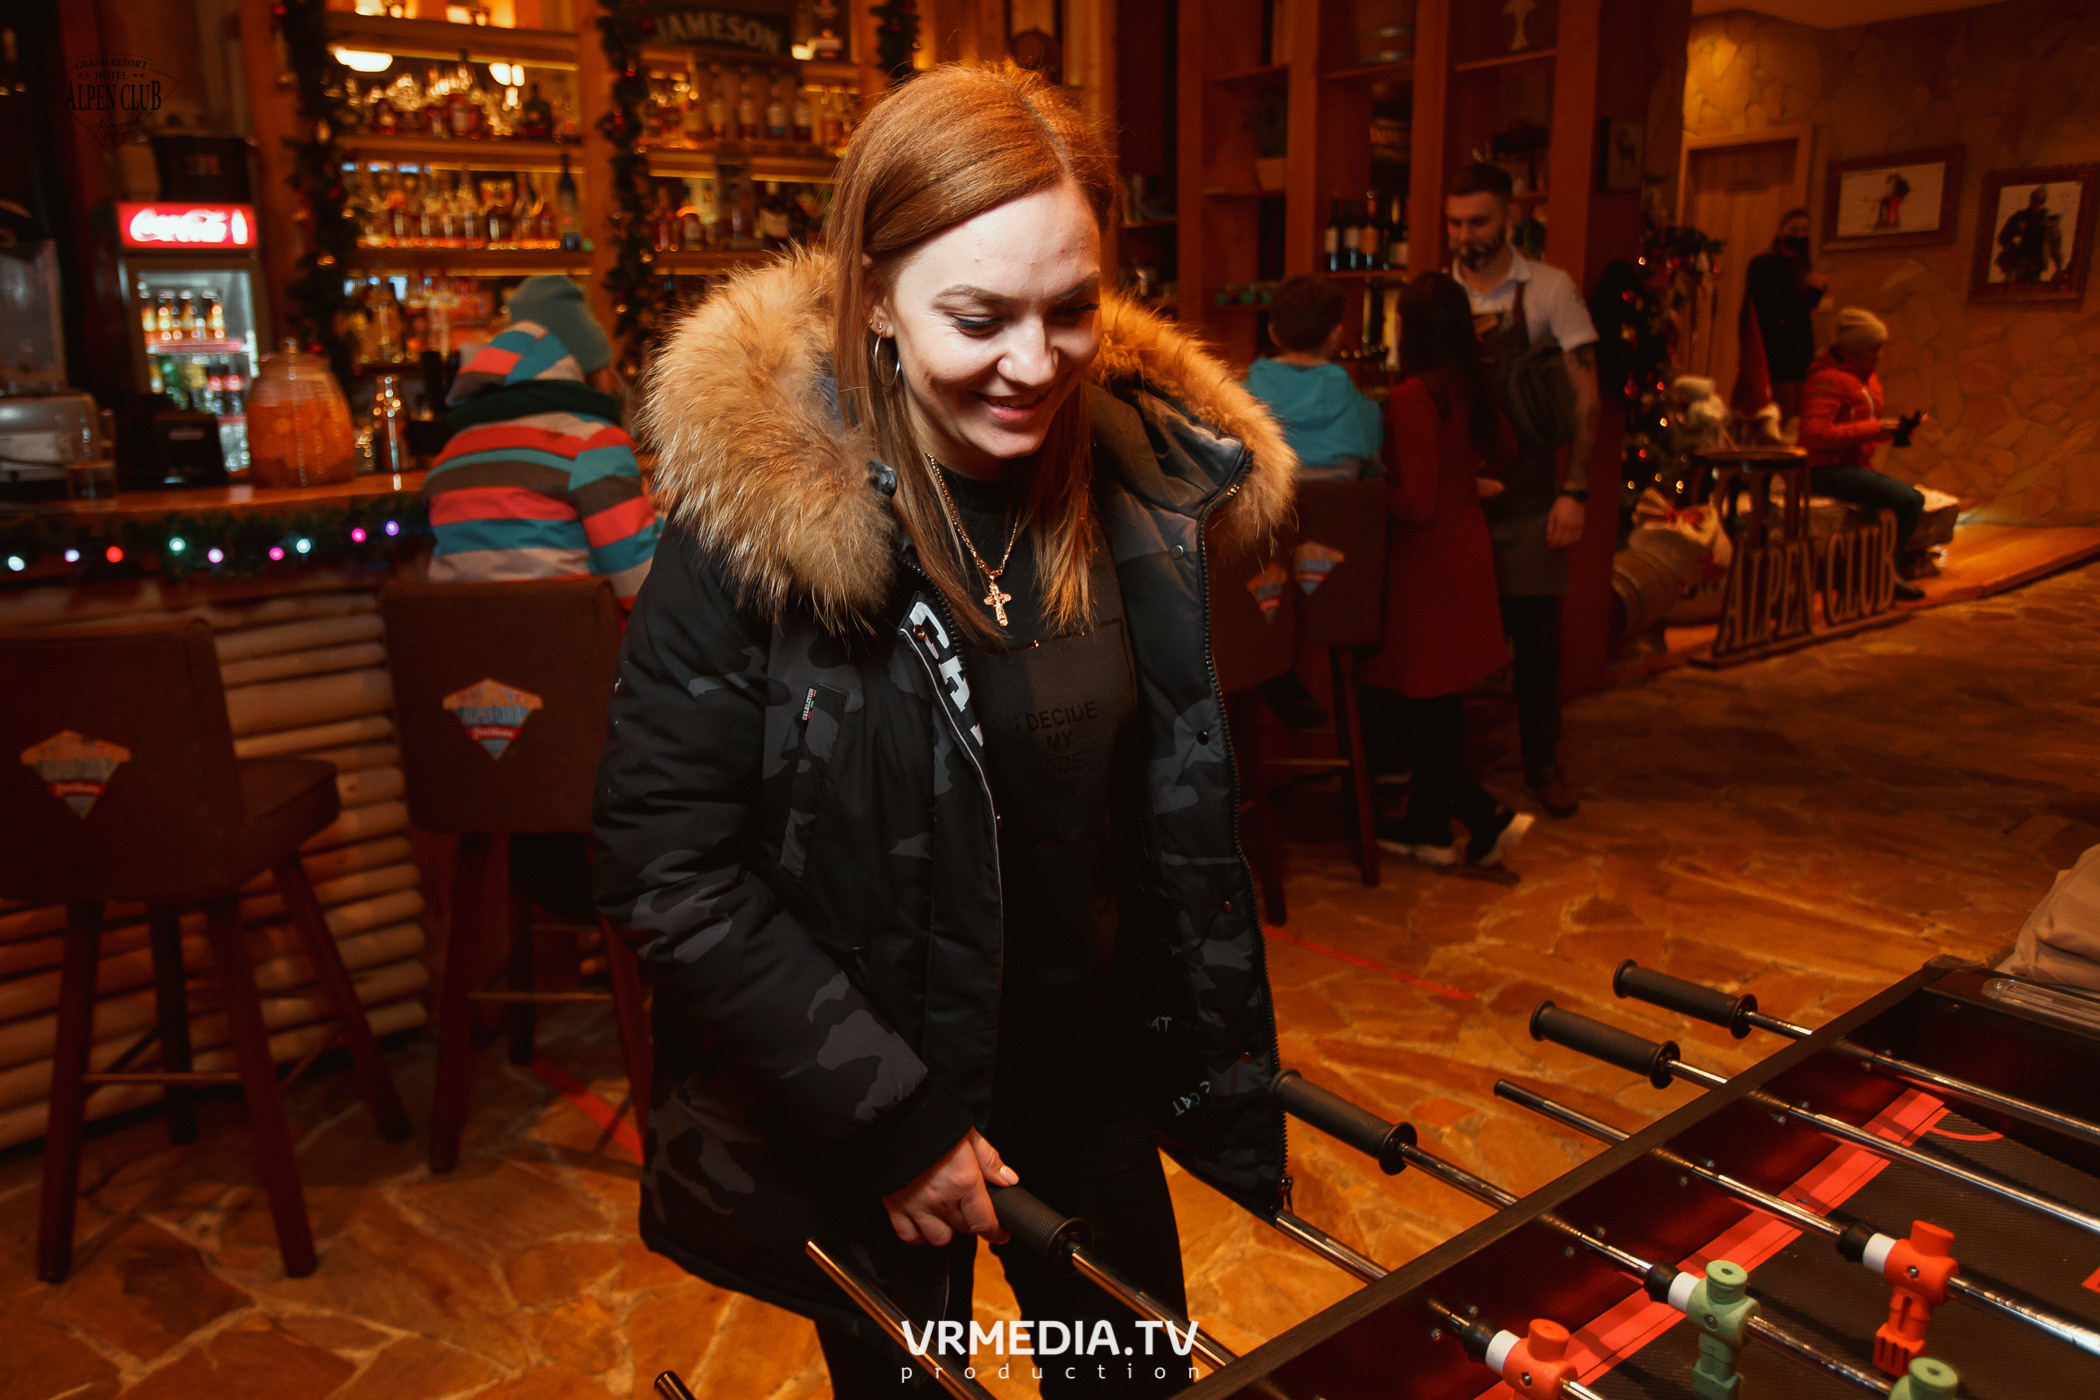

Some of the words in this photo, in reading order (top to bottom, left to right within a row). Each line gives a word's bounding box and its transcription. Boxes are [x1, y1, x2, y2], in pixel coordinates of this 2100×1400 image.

[655, 11, 779, 54] JAMESON
[1713, 536, 1813, 657] ALPEN
[1825, 508, 1898, 627] CLUB
[1026, 701, 1098, 731] DECIDE
[1047, 731, 1072, 751] MY
